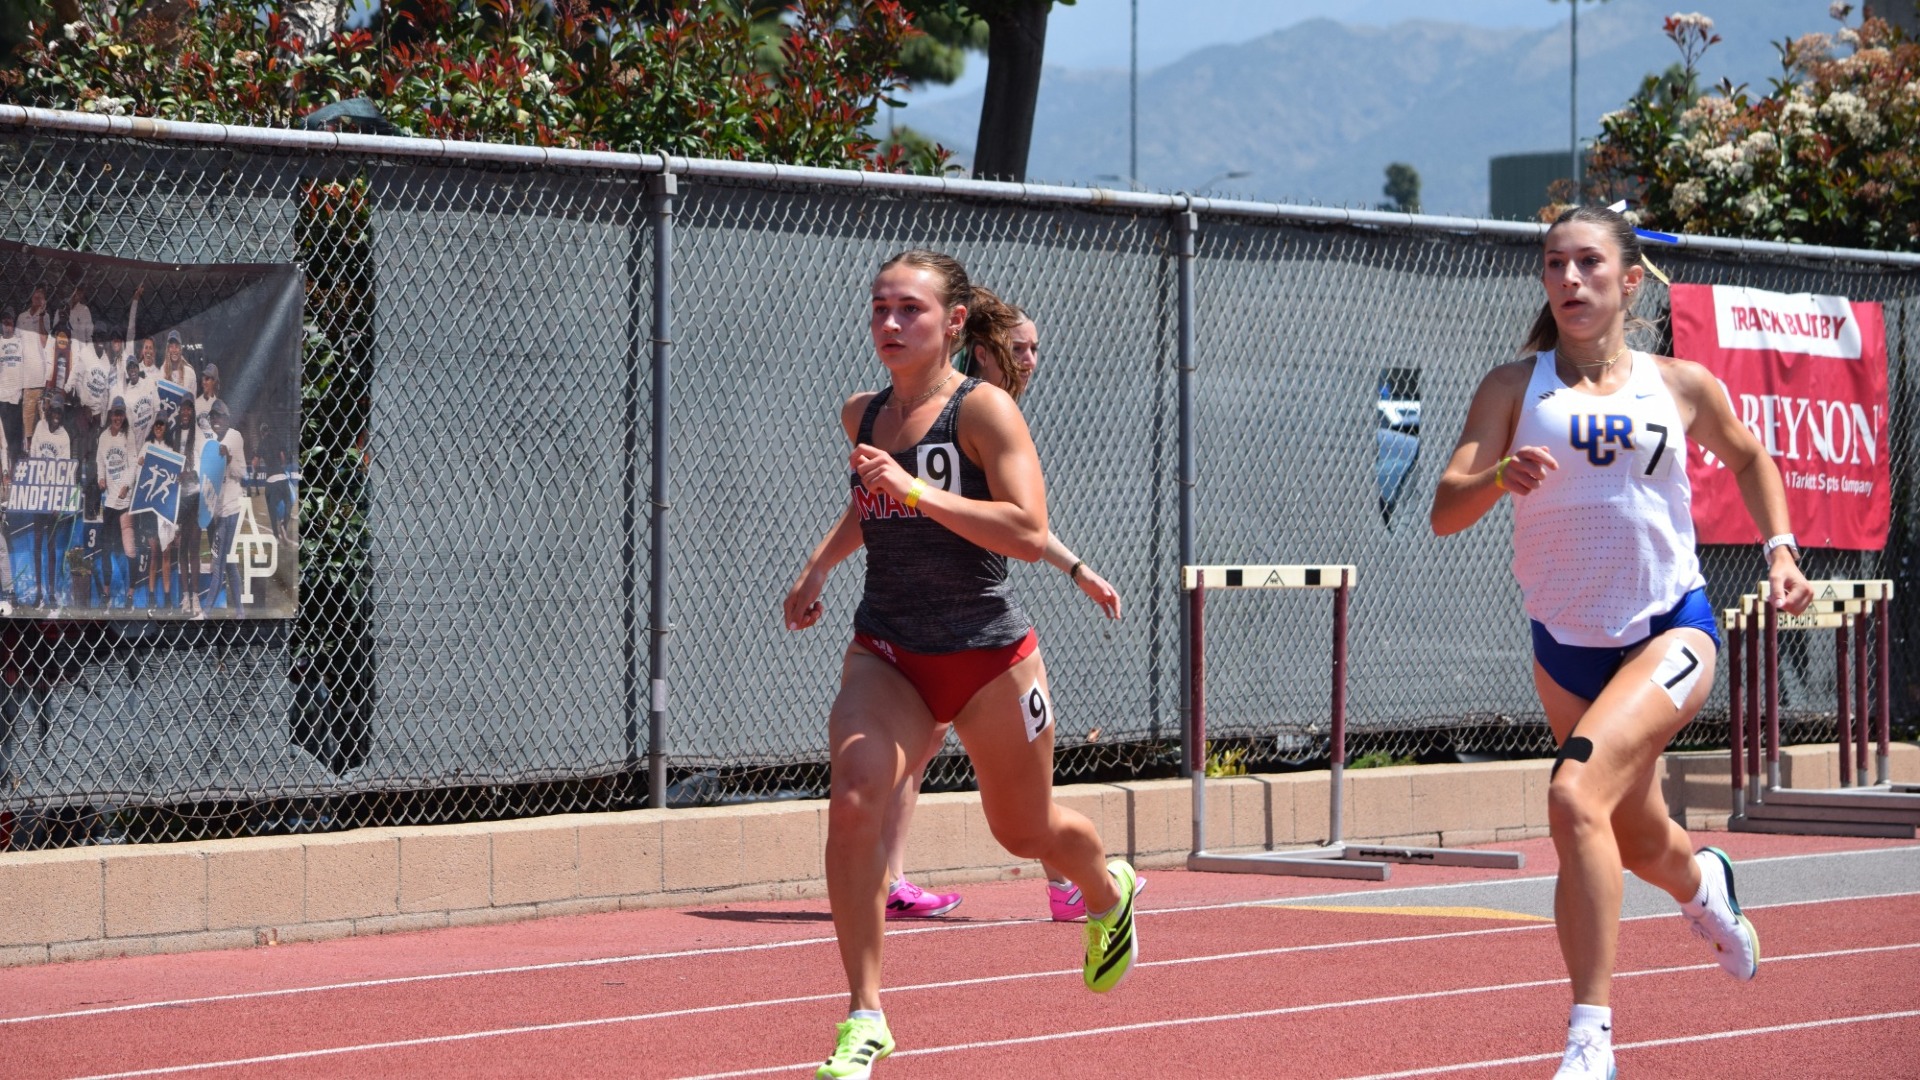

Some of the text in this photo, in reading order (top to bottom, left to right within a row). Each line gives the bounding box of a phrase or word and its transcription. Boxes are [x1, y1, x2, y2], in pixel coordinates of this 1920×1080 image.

[1731, 306, 1786, 334] TRACK
[1819, 315, 1847, 340] BY
[1568, 412, 1636, 468] UCR
[1645, 422, 1668, 476] 7
[14, 460, 79, 486] #TRACK
[925, 446, 952, 492] 9
[87, 528, 97, 548] 3
[1663, 645, 1699, 690] 7
[1028, 686, 1047, 734] 9
